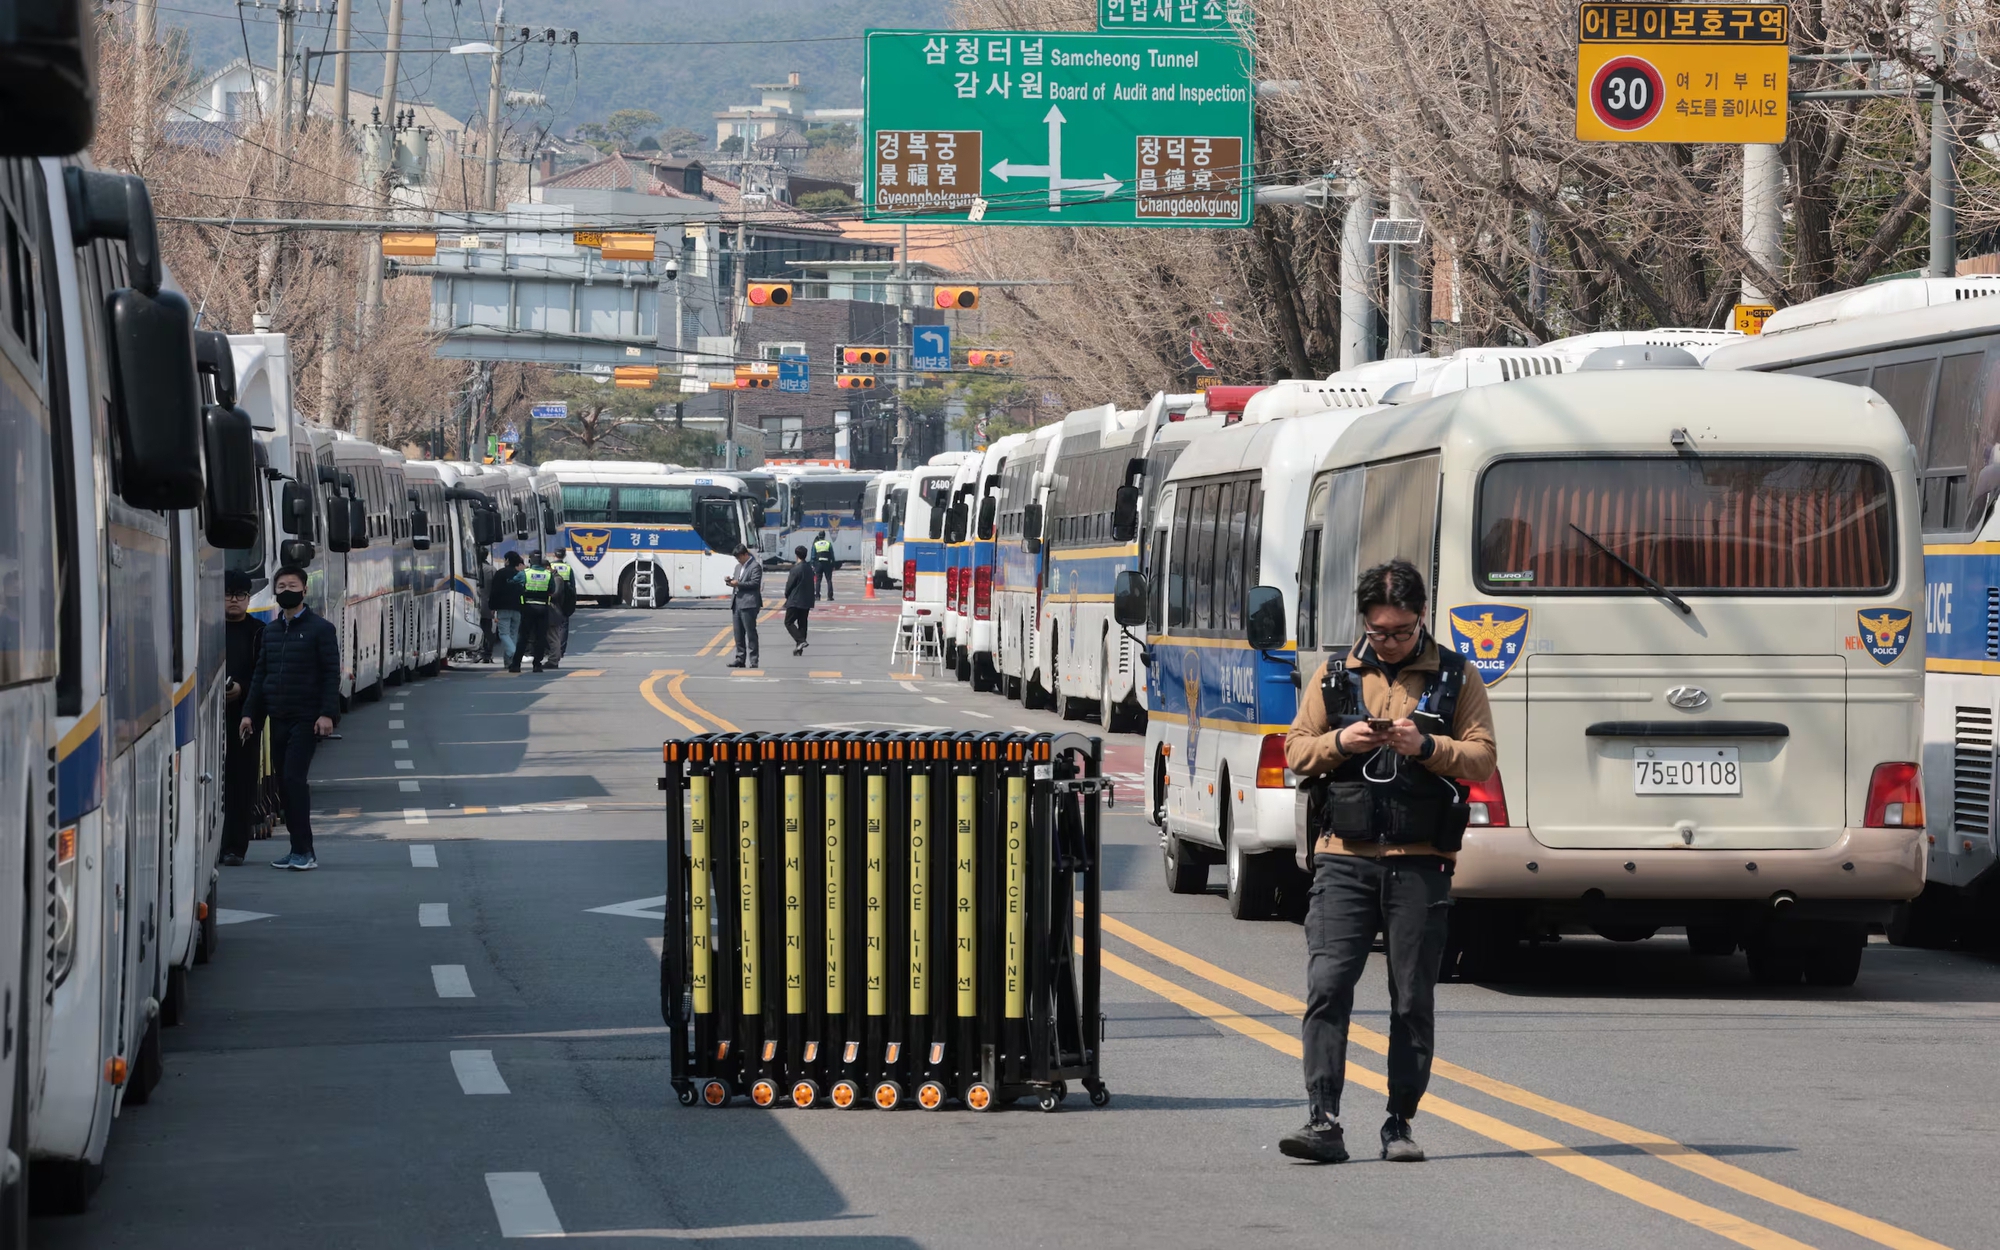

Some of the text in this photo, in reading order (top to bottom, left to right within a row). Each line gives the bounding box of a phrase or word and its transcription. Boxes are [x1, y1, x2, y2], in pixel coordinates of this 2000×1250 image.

[1585, 9, 1782, 39] 어린이보호구역
[922, 37, 1043, 66] 삼청터널
[1051, 49, 1199, 71] Samcheong Tunnel
[954, 71, 1042, 99] 감사원
[1050, 82, 1246, 106] Board of Audit and Inspection
[1608, 77, 1647, 110] 30
[1675, 98, 1777, 118] 속도를 줄이시오
[879, 133, 957, 160] 경복궁
[1140, 138, 1213, 166] 창덕궁
[879, 163, 957, 186] 景福宮
[1140, 195, 1239, 217] Changdeokgung
[914, 357, 949, 370] 비보호
[1925, 583, 1952, 634] LICE
[1233, 667, 1254, 704] POLICE
[1637, 761, 1737, 785] 75모0108
[741, 821, 752, 989] POLICE LINE
[827, 818, 837, 988] POLICE LINE
[912, 819, 923, 990] POLICE LINE
[1008, 821, 1019, 992] POLICE LINE
